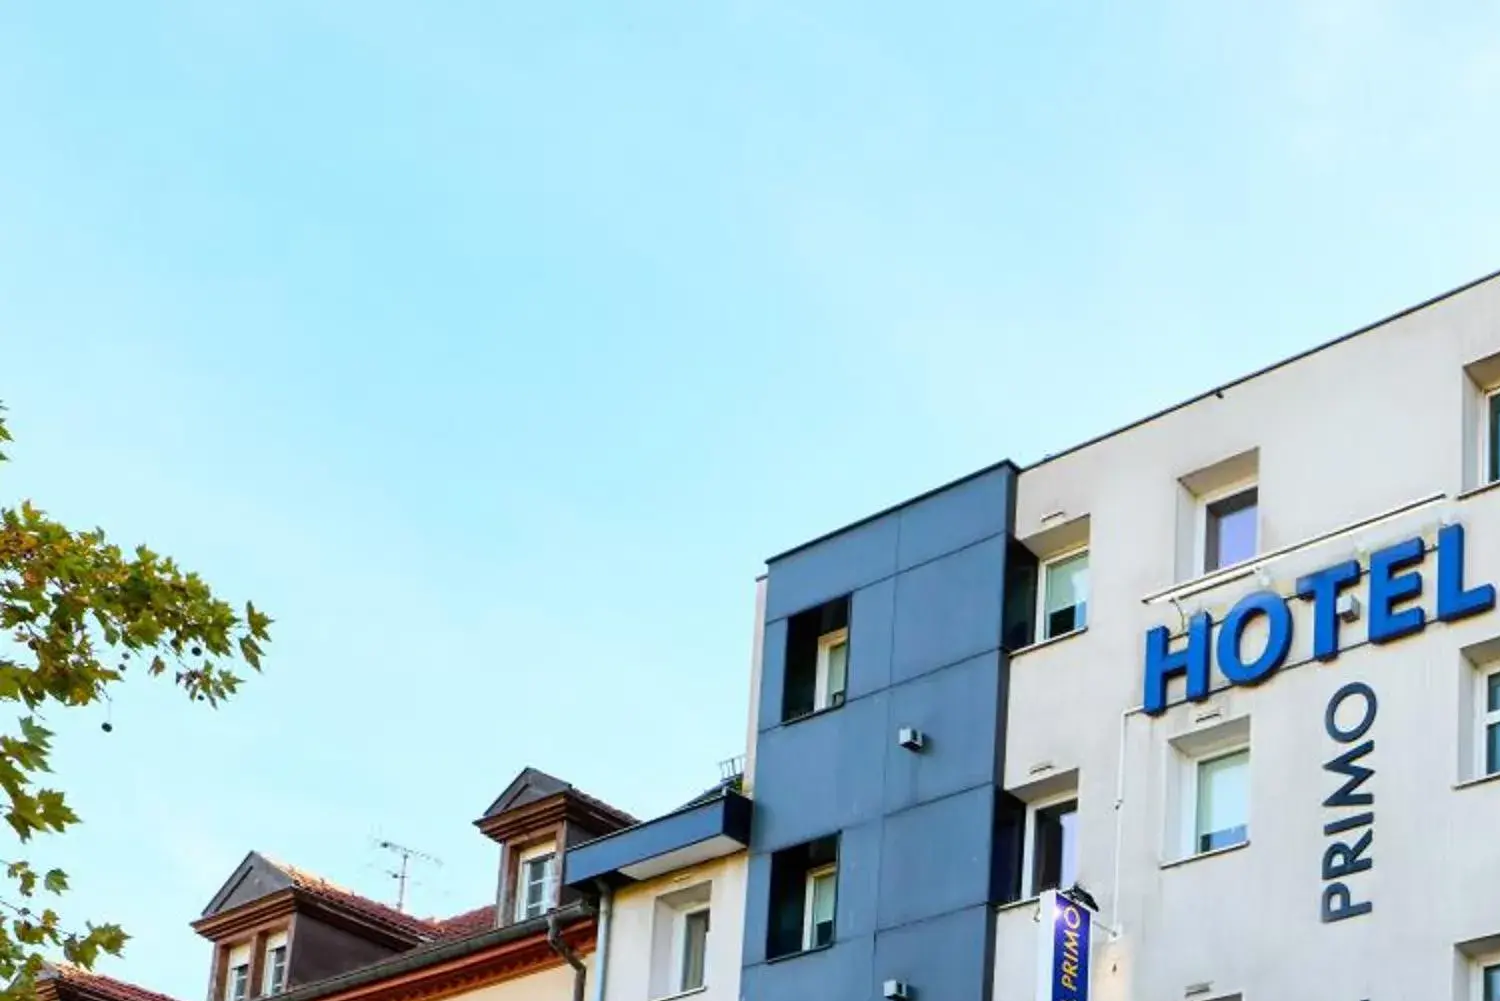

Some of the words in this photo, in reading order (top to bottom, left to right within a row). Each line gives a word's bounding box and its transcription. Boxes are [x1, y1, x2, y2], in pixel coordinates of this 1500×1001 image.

[1143, 523, 1496, 716] HOTEL
[1322, 682, 1377, 923] PRIMO
[1061, 906, 1080, 991] PRIMO
